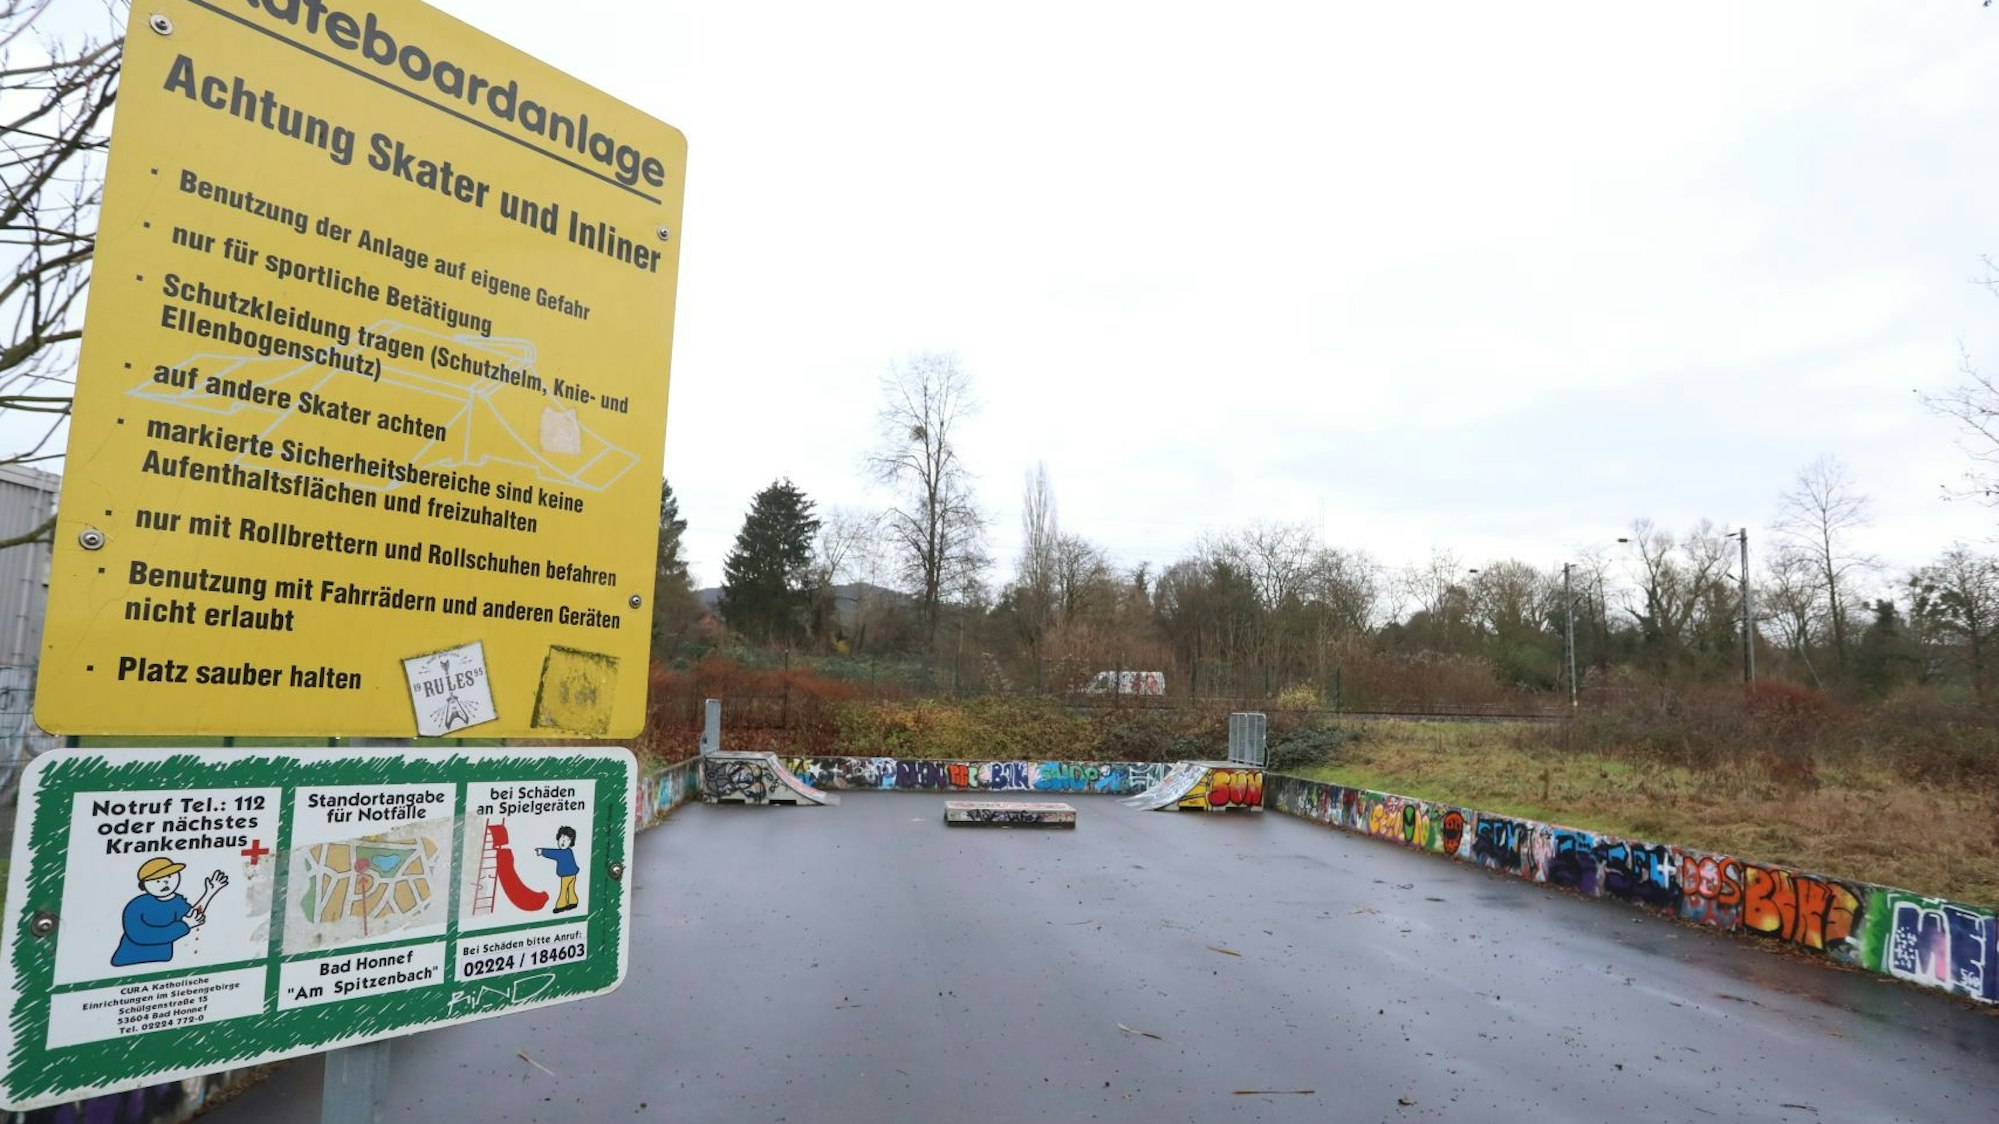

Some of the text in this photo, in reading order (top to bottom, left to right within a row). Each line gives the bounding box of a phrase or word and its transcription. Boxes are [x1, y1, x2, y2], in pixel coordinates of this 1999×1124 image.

[247, 0, 665, 187] ateboardanlage
[162, 53, 661, 273] Achtung Skater und Inliner
[179, 168, 590, 320] Benutzung der Anlage auf eigene Gefahr
[172, 226, 492, 338] nur für sportliche Betätigung
[161, 304, 381, 383] Ellenbogenschutz)
[162, 273, 629, 414] Schutzkleidung tragen (Schutzhelm, Knie- und
[153, 365, 446, 442] auf andere Skater achten
[146, 419, 584, 513] markierte Sicherheitsbereiche sind keine
[141, 449, 537, 533] Aufenthaltsflächen und freizuhalten
[135, 509, 616, 587] nur mit Rollbrettern und Rollschuhen befahren
[128, 560, 620, 629] Benutzung mit Fahrrädern und anderen Geräten
[124, 597, 294, 632] nicht erlaubt
[117, 656, 361, 690] Platz sauber halten
[423, 669, 475, 698] RULES
[473, 667, 484, 678] 95
[92, 795, 265, 817] Notruf Tel.: 112
[307, 790, 445, 809] Standortangabe
[476, 799, 585, 817] an Spielgeräten
[490, 785, 575, 800] bei Schäden
[97, 815, 258, 836] oder nächstes
[327, 805, 426, 823] für Notfälle
[106, 833, 248, 855] Krankenhaus
[463, 929, 583, 956] Bei Schäden bitte Anruf:
[319, 950, 413, 976] Bad Honnef
[463, 943, 585, 977] 02224 / 184603
[82, 995, 153, 1011] Einrichtungen
[170, 982, 240, 998] Siebengebirge
[151, 977, 209, 991] Katholische
[287, 965, 438, 1001] "Am Spitzenbach"
[118, 995, 208, 1015] Schülgenstraße 15
[152, 1010, 171, 1019] Bad
[173, 1004, 208, 1016] Honnef
[119, 1025, 138, 1034] Tel.
[141, 1019, 173, 1031] 02224
